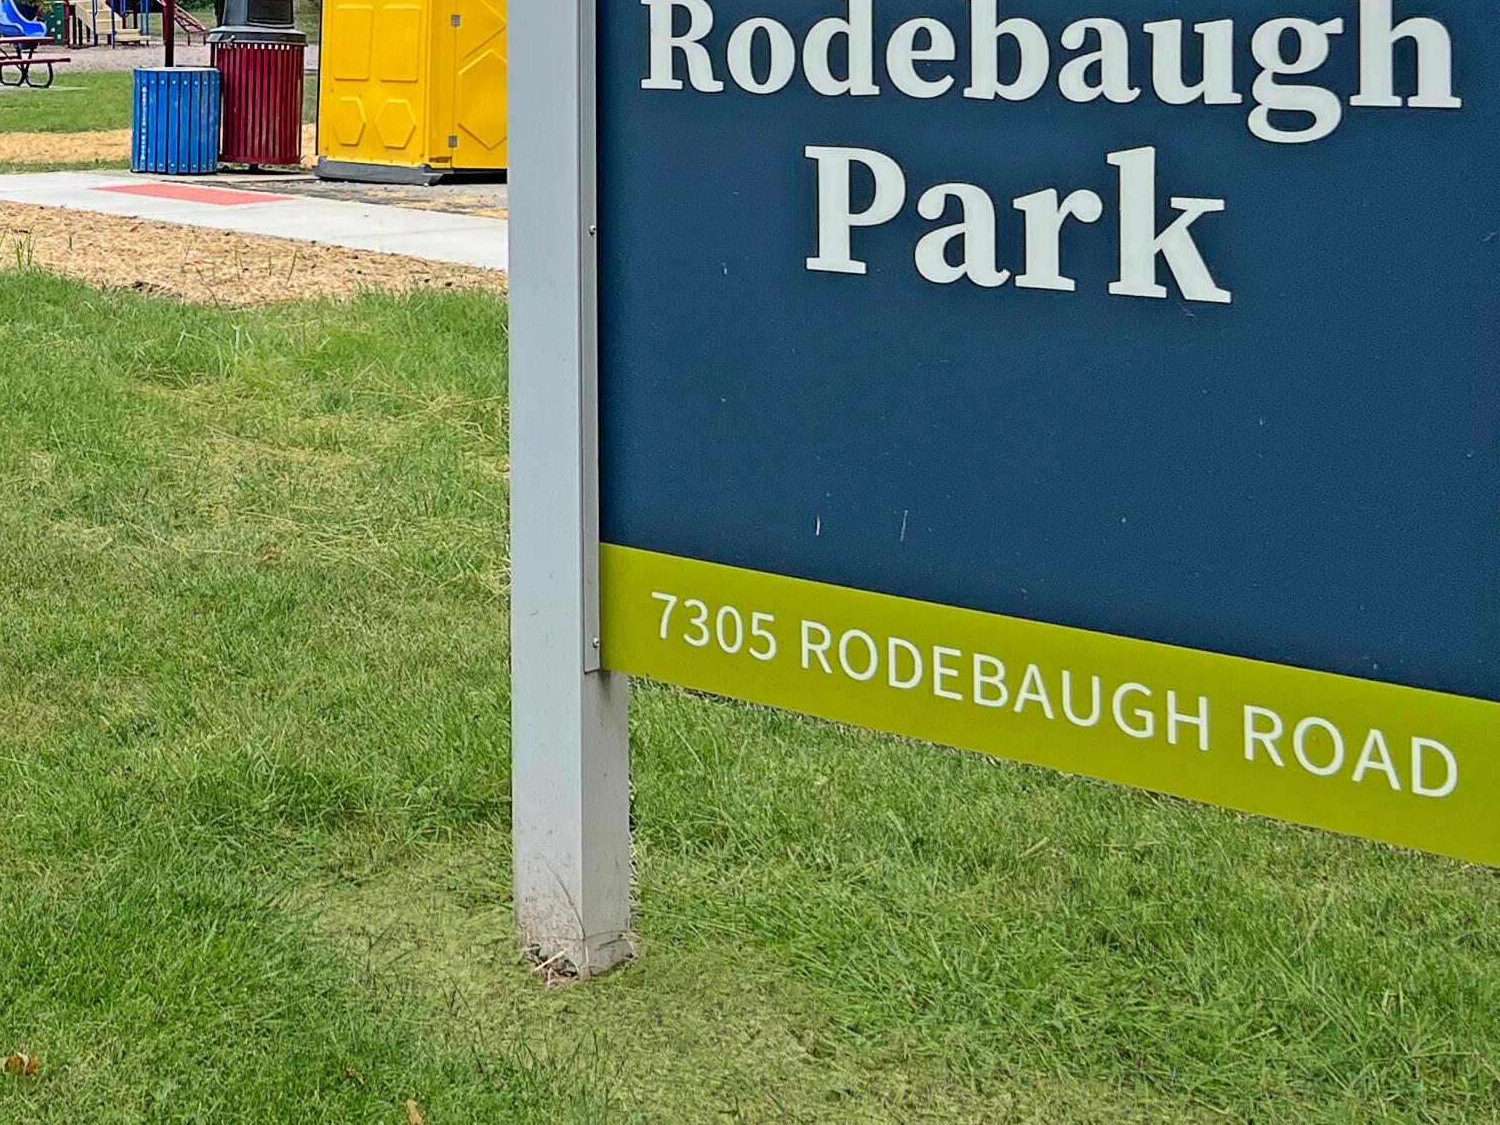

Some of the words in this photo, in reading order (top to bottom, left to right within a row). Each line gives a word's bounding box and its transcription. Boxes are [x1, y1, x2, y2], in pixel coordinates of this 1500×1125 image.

[803, 144, 1233, 305] Park
[650, 591, 778, 662] 7305
[800, 618, 1209, 752] RODEBAUGH
[1243, 704, 1459, 798] ROAD
